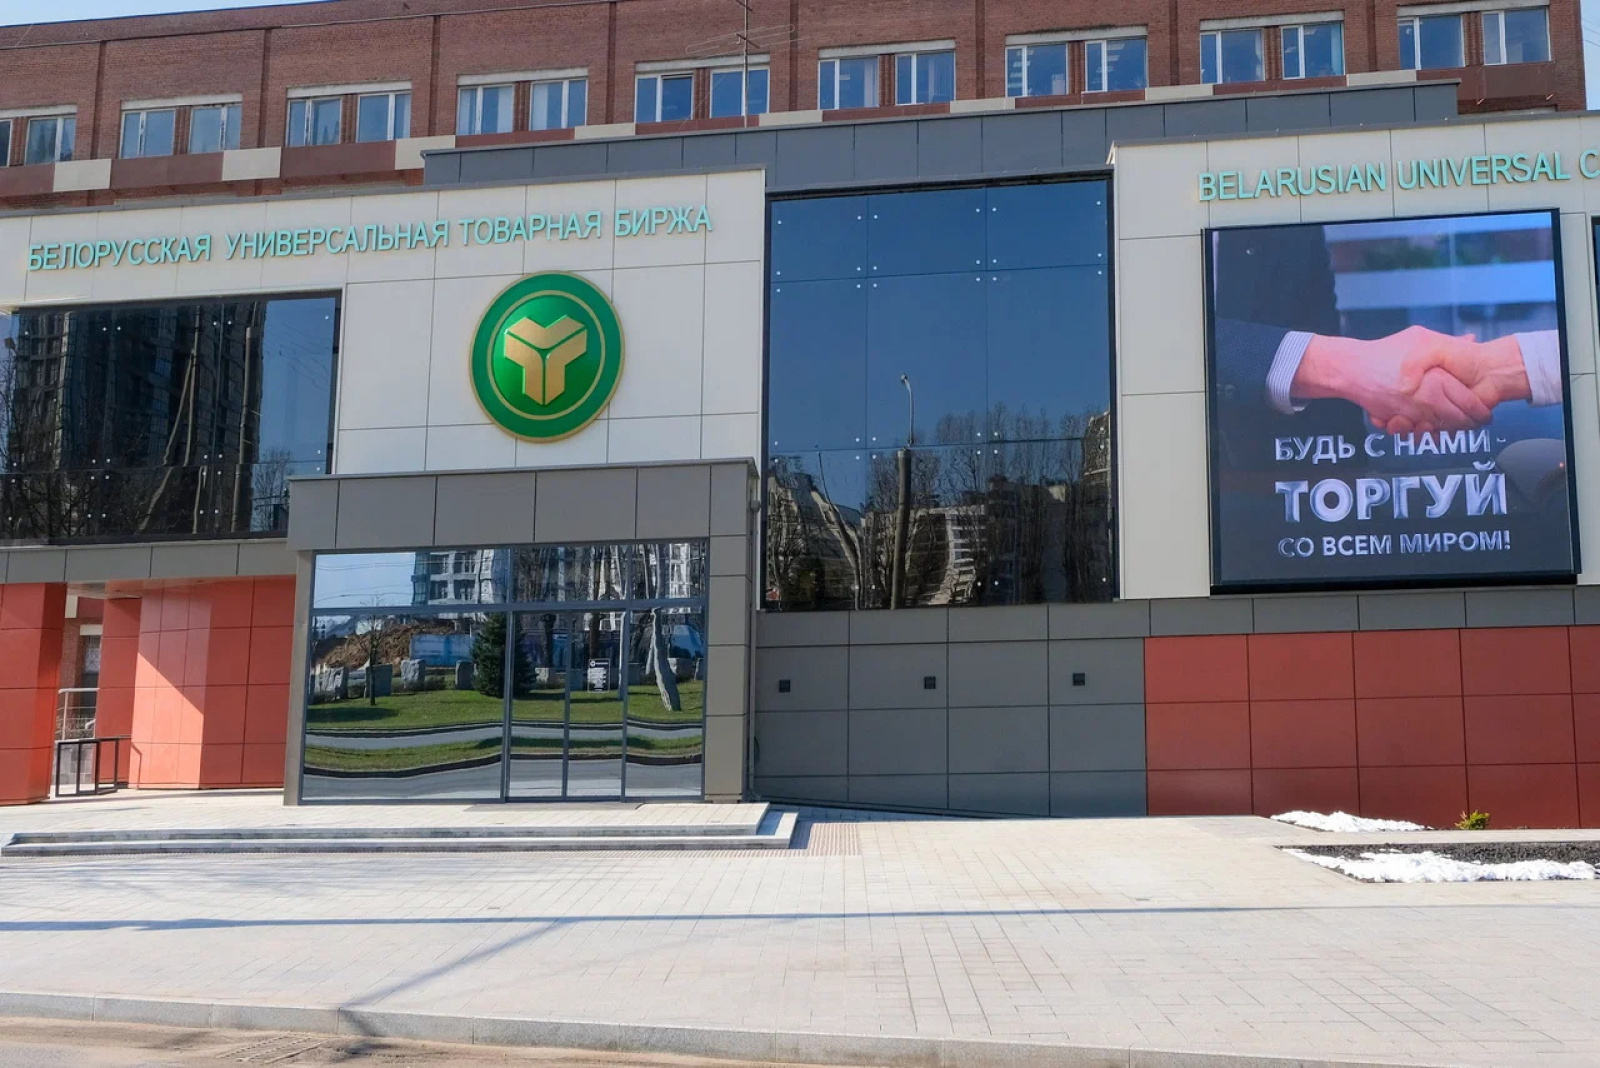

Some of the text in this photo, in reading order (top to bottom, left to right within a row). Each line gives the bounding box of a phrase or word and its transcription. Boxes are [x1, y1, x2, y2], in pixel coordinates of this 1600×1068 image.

[1199, 162, 1386, 200] BELARUSIAN
[1398, 151, 1571, 189] UNIVERSAL
[27, 204, 714, 272] БЕЛОРУССКАЯ УНИВЕРСАЛЬНАЯ ТОВАРНАЯ БИРЖА
[1274, 434, 1356, 465] БУДЬ
[1364, 433, 1386, 458] С
[1394, 429, 1491, 456] НАМИ
[1274, 460, 1507, 523] ТОРГУЙ
[1277, 529, 1511, 558] СО ВСЕМ МИРОМ!
